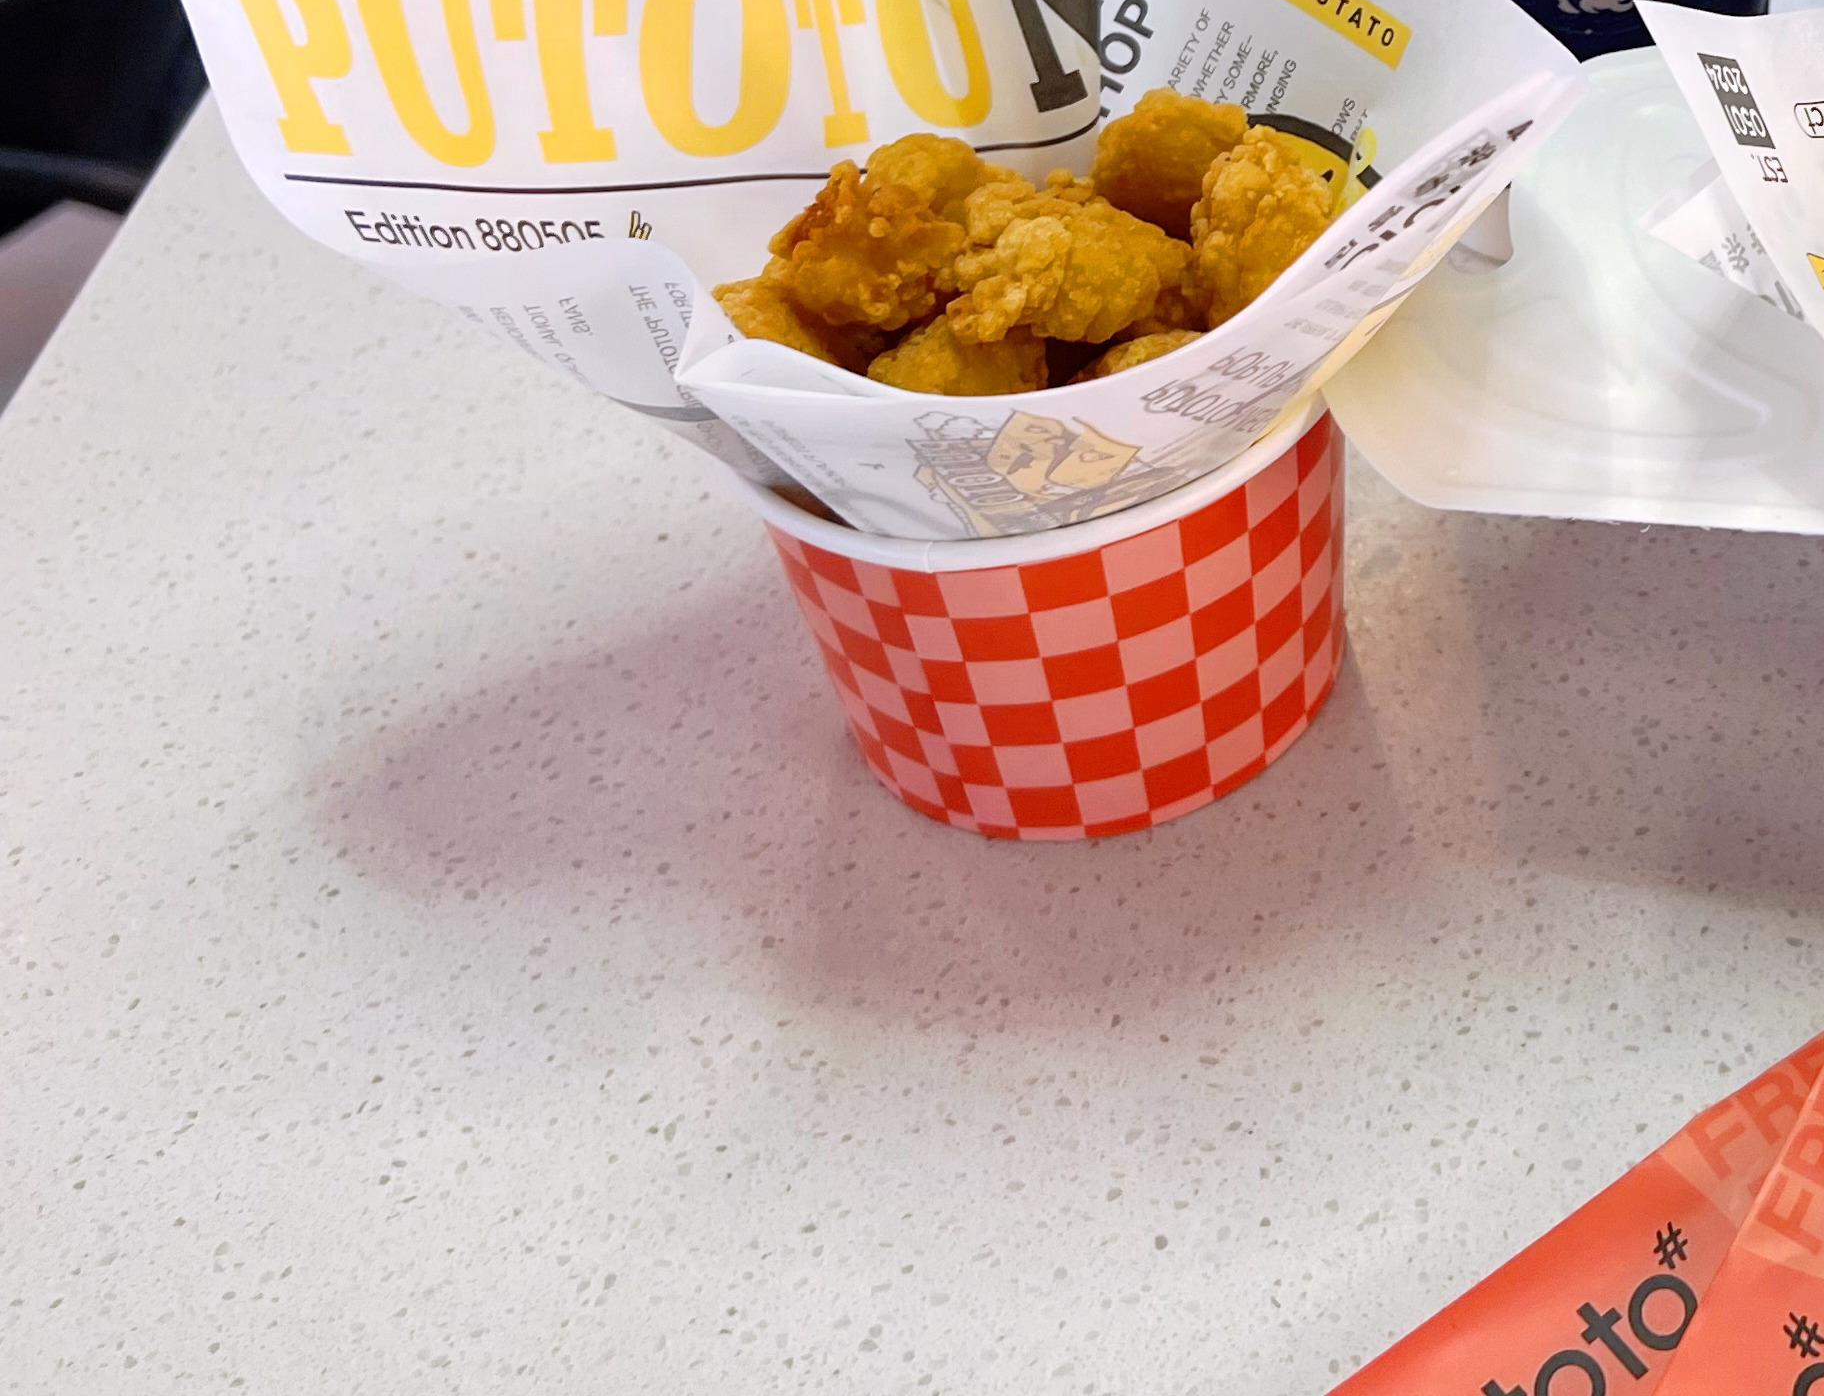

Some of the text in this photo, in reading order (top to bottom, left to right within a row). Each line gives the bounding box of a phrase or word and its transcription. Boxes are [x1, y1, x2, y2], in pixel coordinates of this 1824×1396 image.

[1195, 7, 1211, 32] OF
[1190, 21, 1235, 98] WHETHER
[1705, 63, 1749, 95] 2024
[1725, 104, 1767, 138] 0501
[344, 209, 476, 251] Edition
